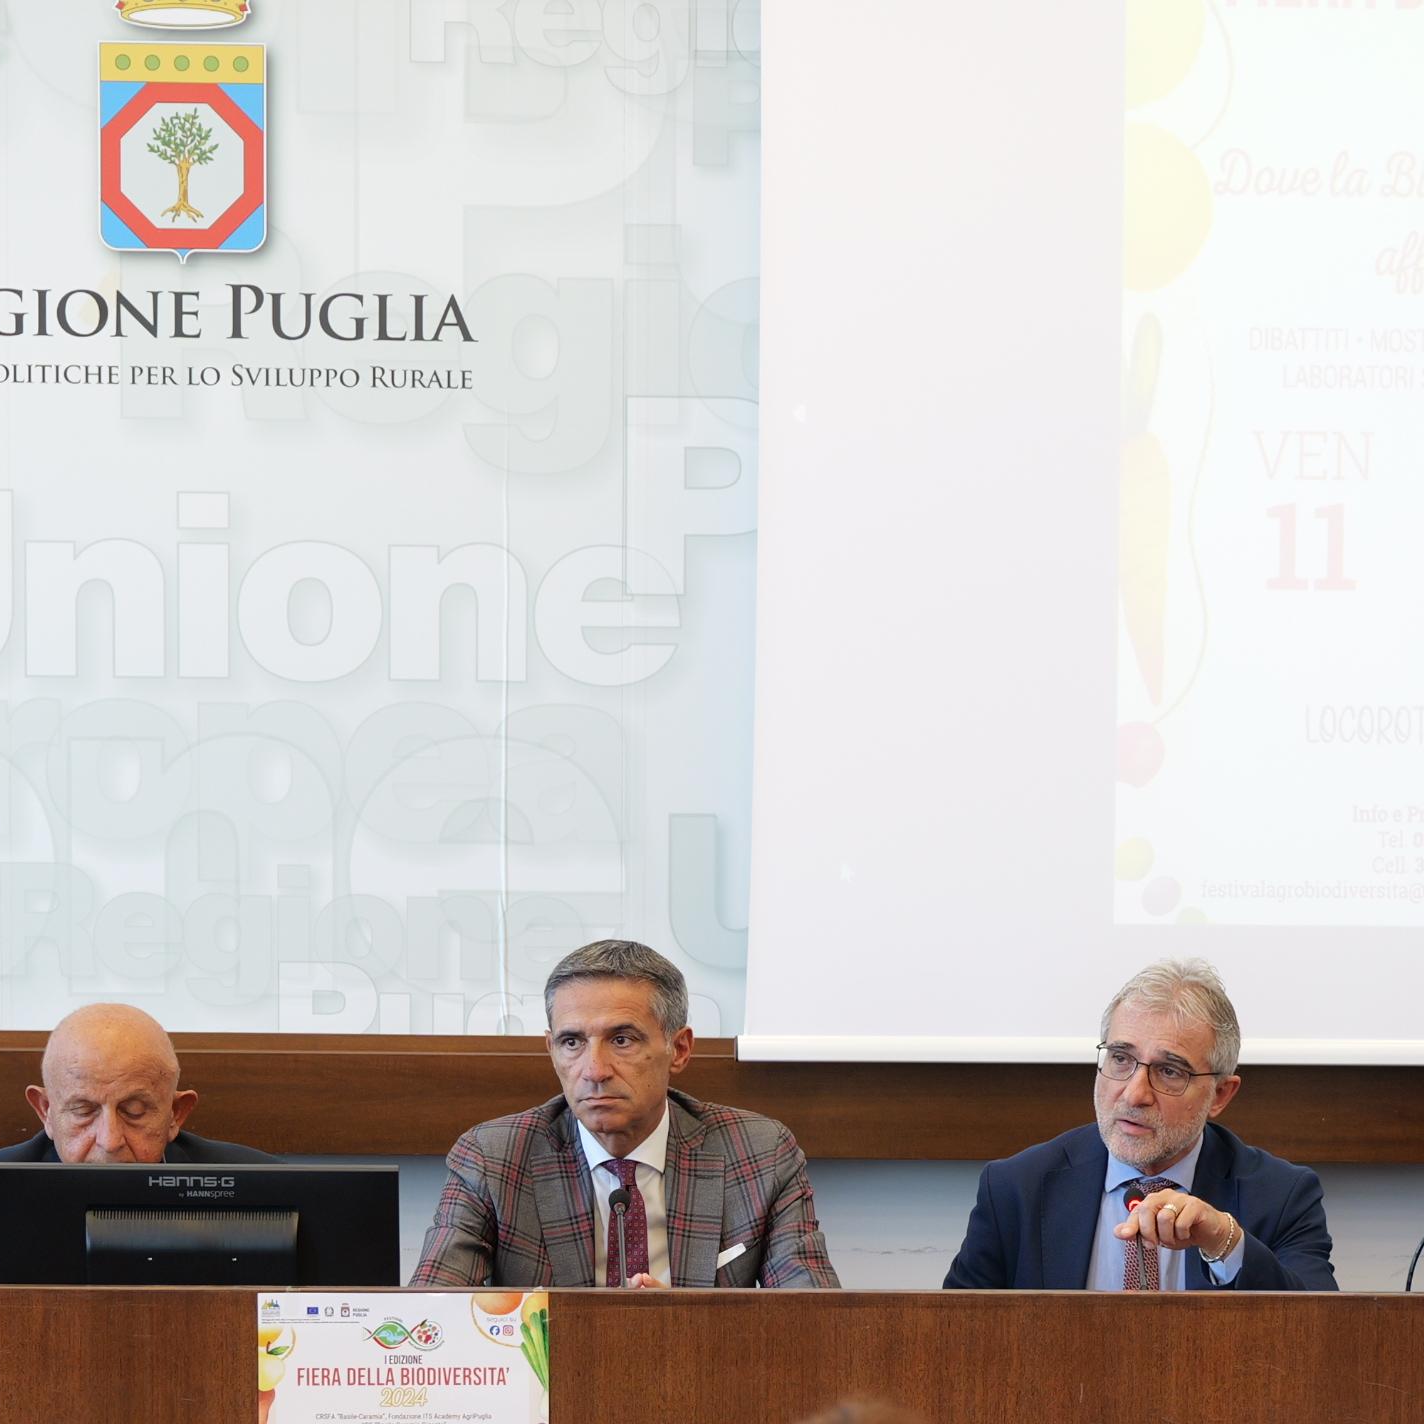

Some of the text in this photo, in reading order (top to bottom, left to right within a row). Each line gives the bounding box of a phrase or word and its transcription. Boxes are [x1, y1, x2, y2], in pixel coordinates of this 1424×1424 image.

[1251, 429, 1376, 483] VEN
[1263, 501, 1358, 592] 11
[389, 1355, 422, 1364] EDIZIONE
[298, 1367, 509, 1386] FIERA DELLA BIODIVERSITA'
[379, 1386, 428, 1407] 2024
